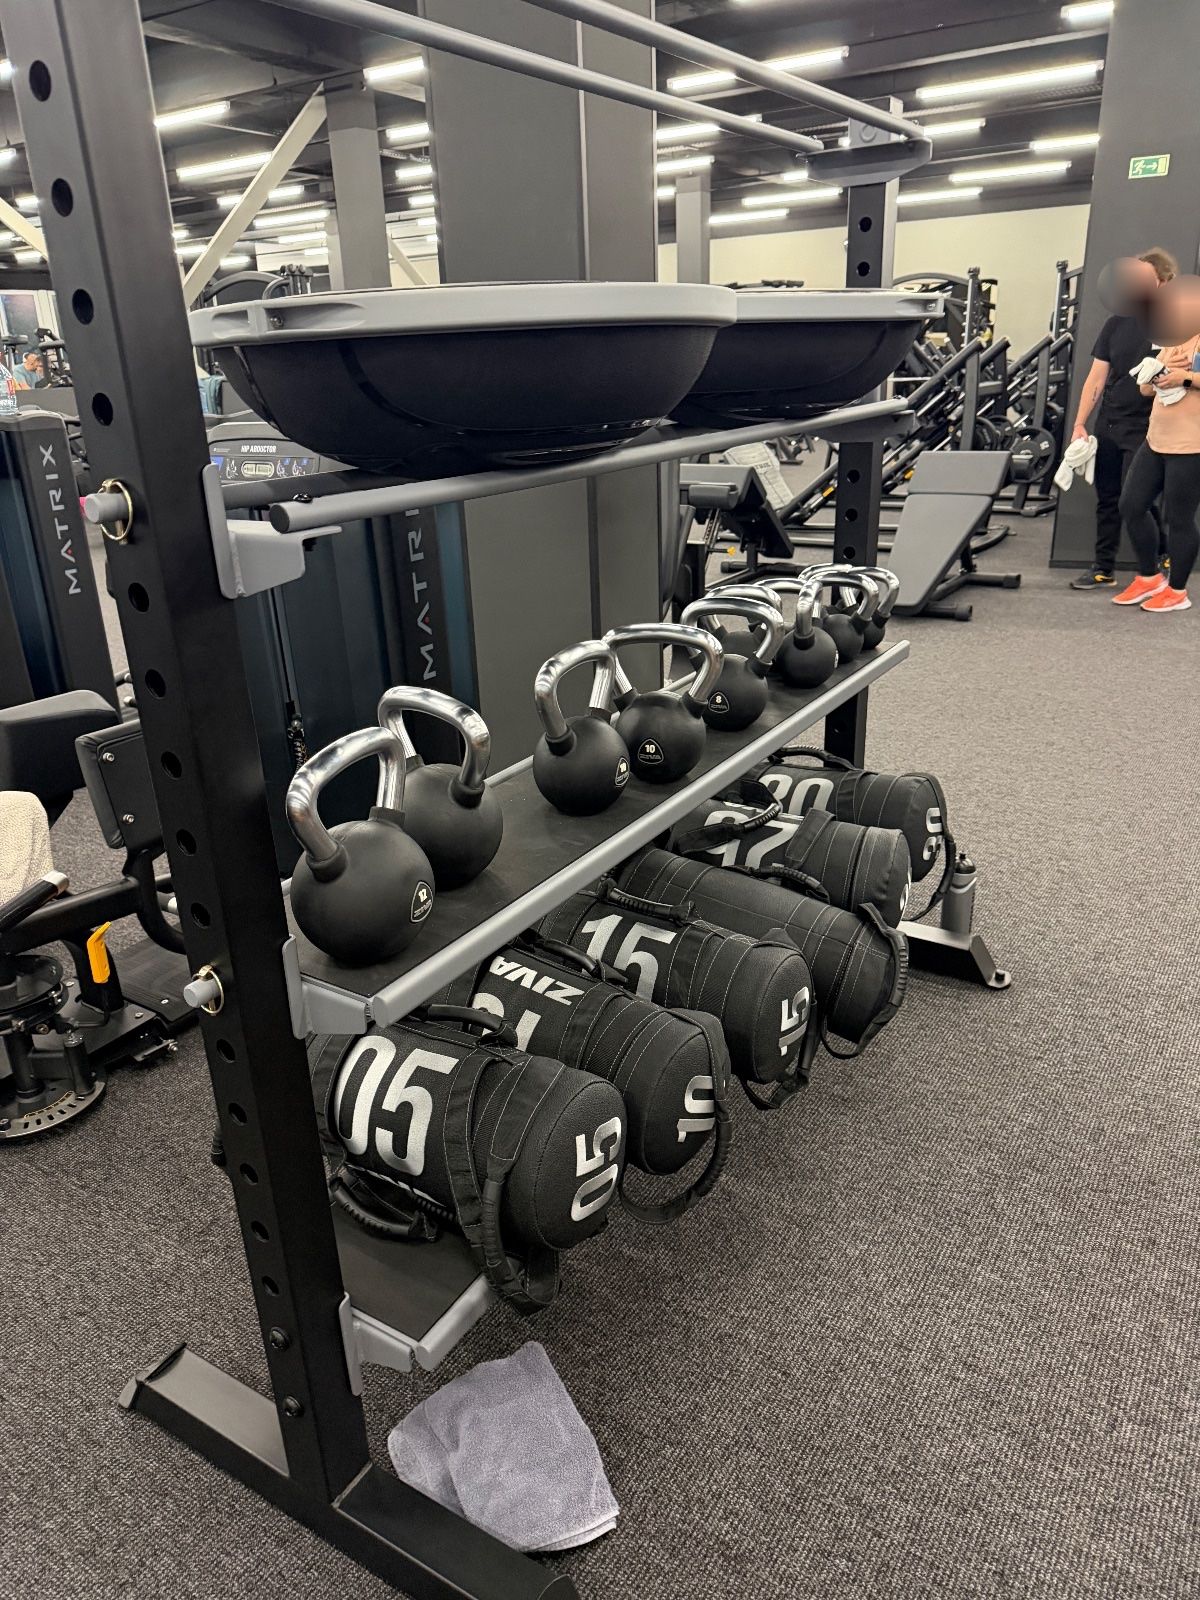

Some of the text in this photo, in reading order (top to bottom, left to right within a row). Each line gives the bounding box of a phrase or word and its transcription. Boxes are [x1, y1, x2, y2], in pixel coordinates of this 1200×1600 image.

[39, 444, 82, 595] MATRIX
[404, 508, 437, 681] MATRI
[716, 695, 722, 704] 8
[644, 744, 656, 754] 10
[489, 955, 585, 1006] ZIVA
[581, 914, 678, 1002] 15
[778, 986, 810, 1057] 15
[334, 1035, 459, 1176] 05
[677, 1074, 716, 1143] 10
[571, 1116, 622, 1223] 05
